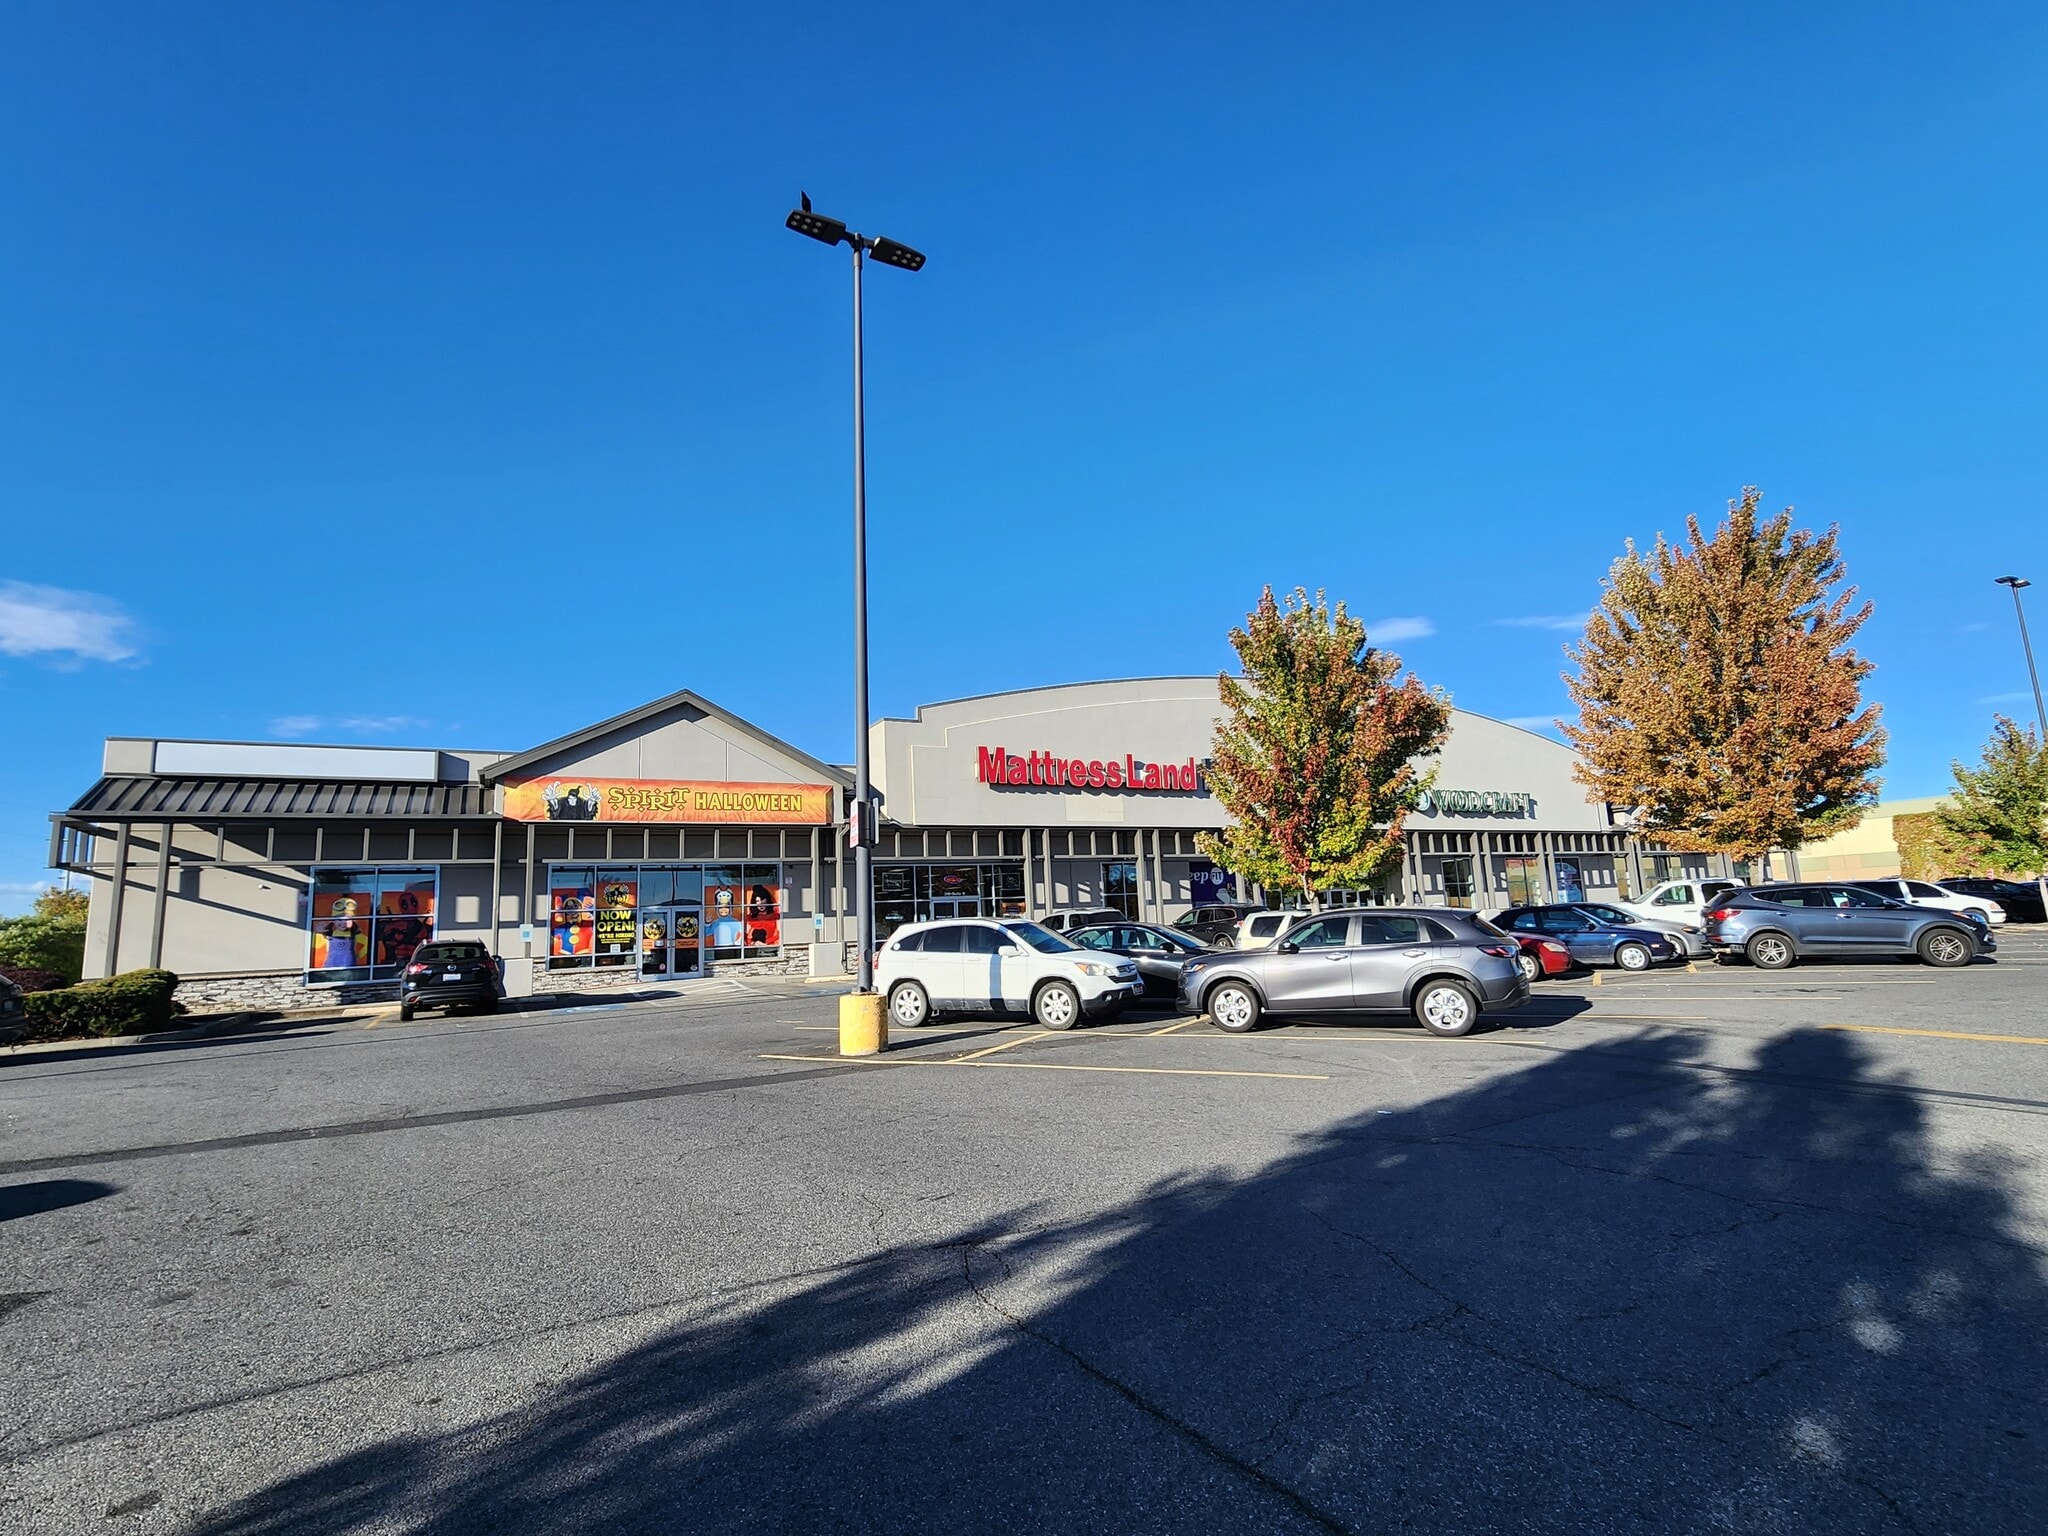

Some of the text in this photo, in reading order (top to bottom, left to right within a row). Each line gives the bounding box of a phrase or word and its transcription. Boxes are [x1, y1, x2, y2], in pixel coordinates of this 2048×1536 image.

[608, 787, 802, 812] SPIRIT HALLOWEEN
[600, 911, 631, 920] NOW
